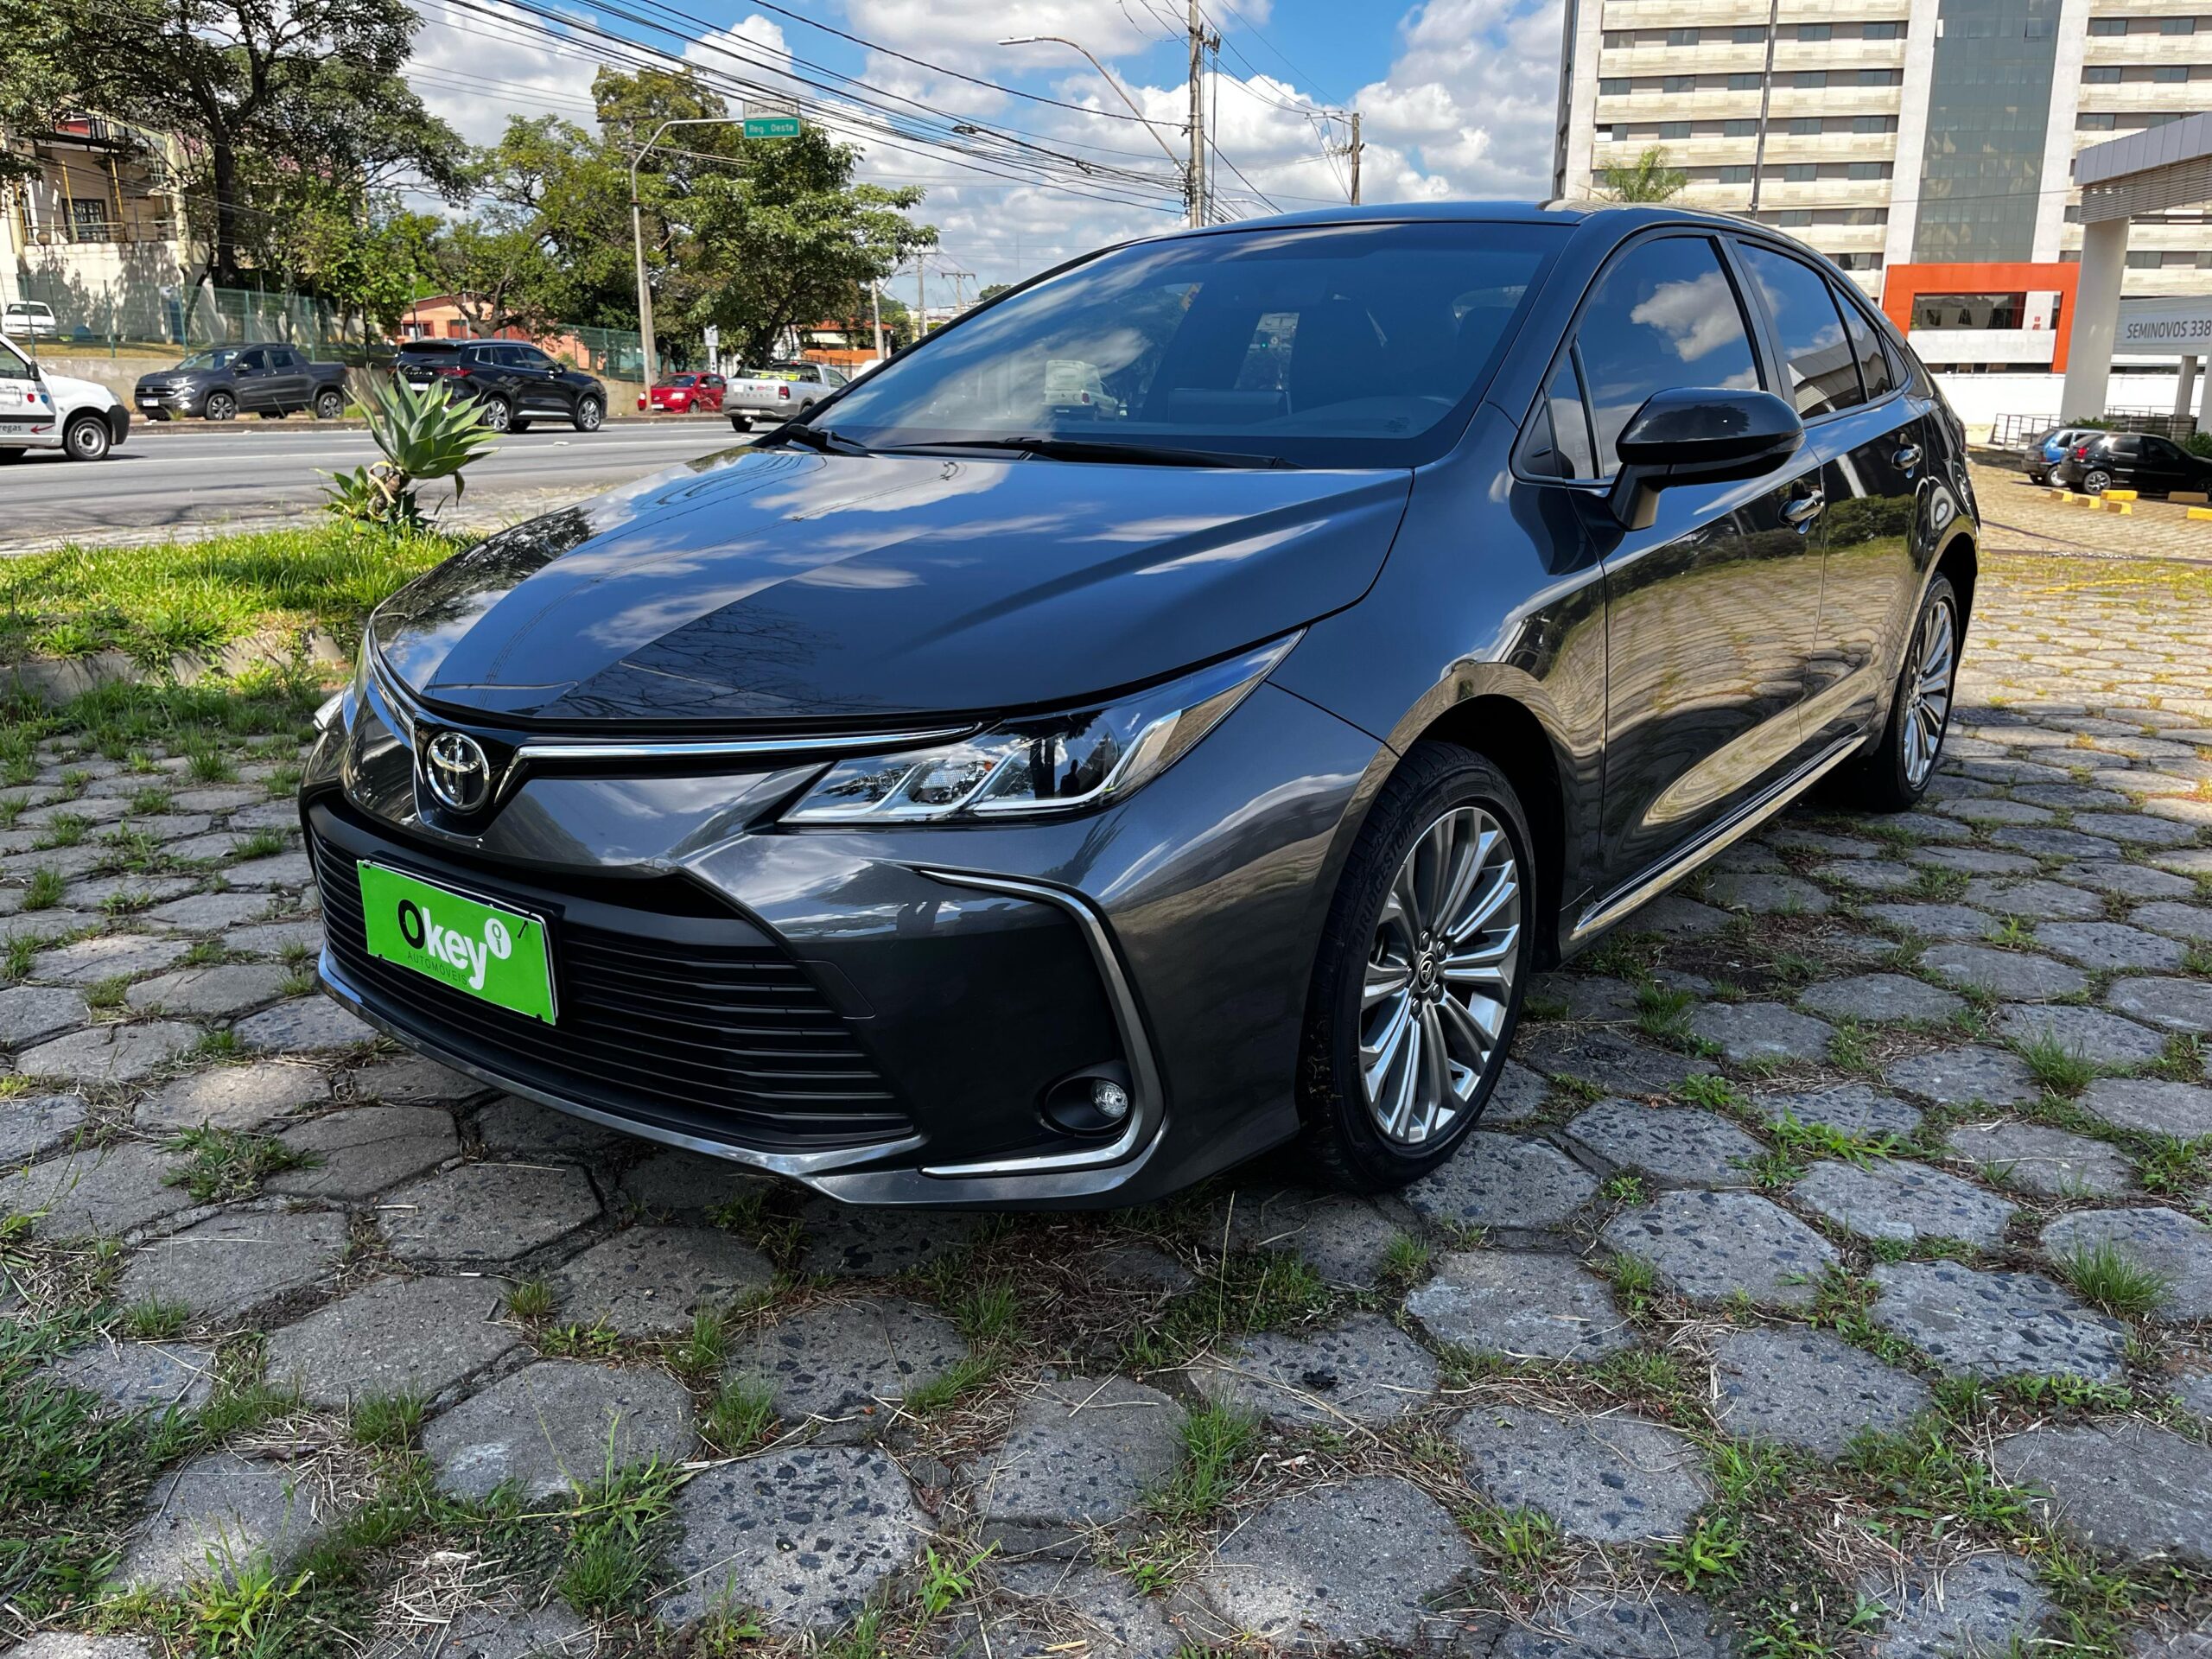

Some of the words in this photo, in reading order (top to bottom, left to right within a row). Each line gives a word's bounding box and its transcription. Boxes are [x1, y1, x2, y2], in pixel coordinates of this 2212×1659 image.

[770, 124, 794, 132] Oeste
[2126, 321, 2188, 339] SEMINOVOS
[2190, 320, 2212, 337] 338
[1353, 812, 1418, 948] BRIDGESTONE
[397, 899, 487, 990] Okey
[407, 950, 467, 985] AUTOMÓVEIS
